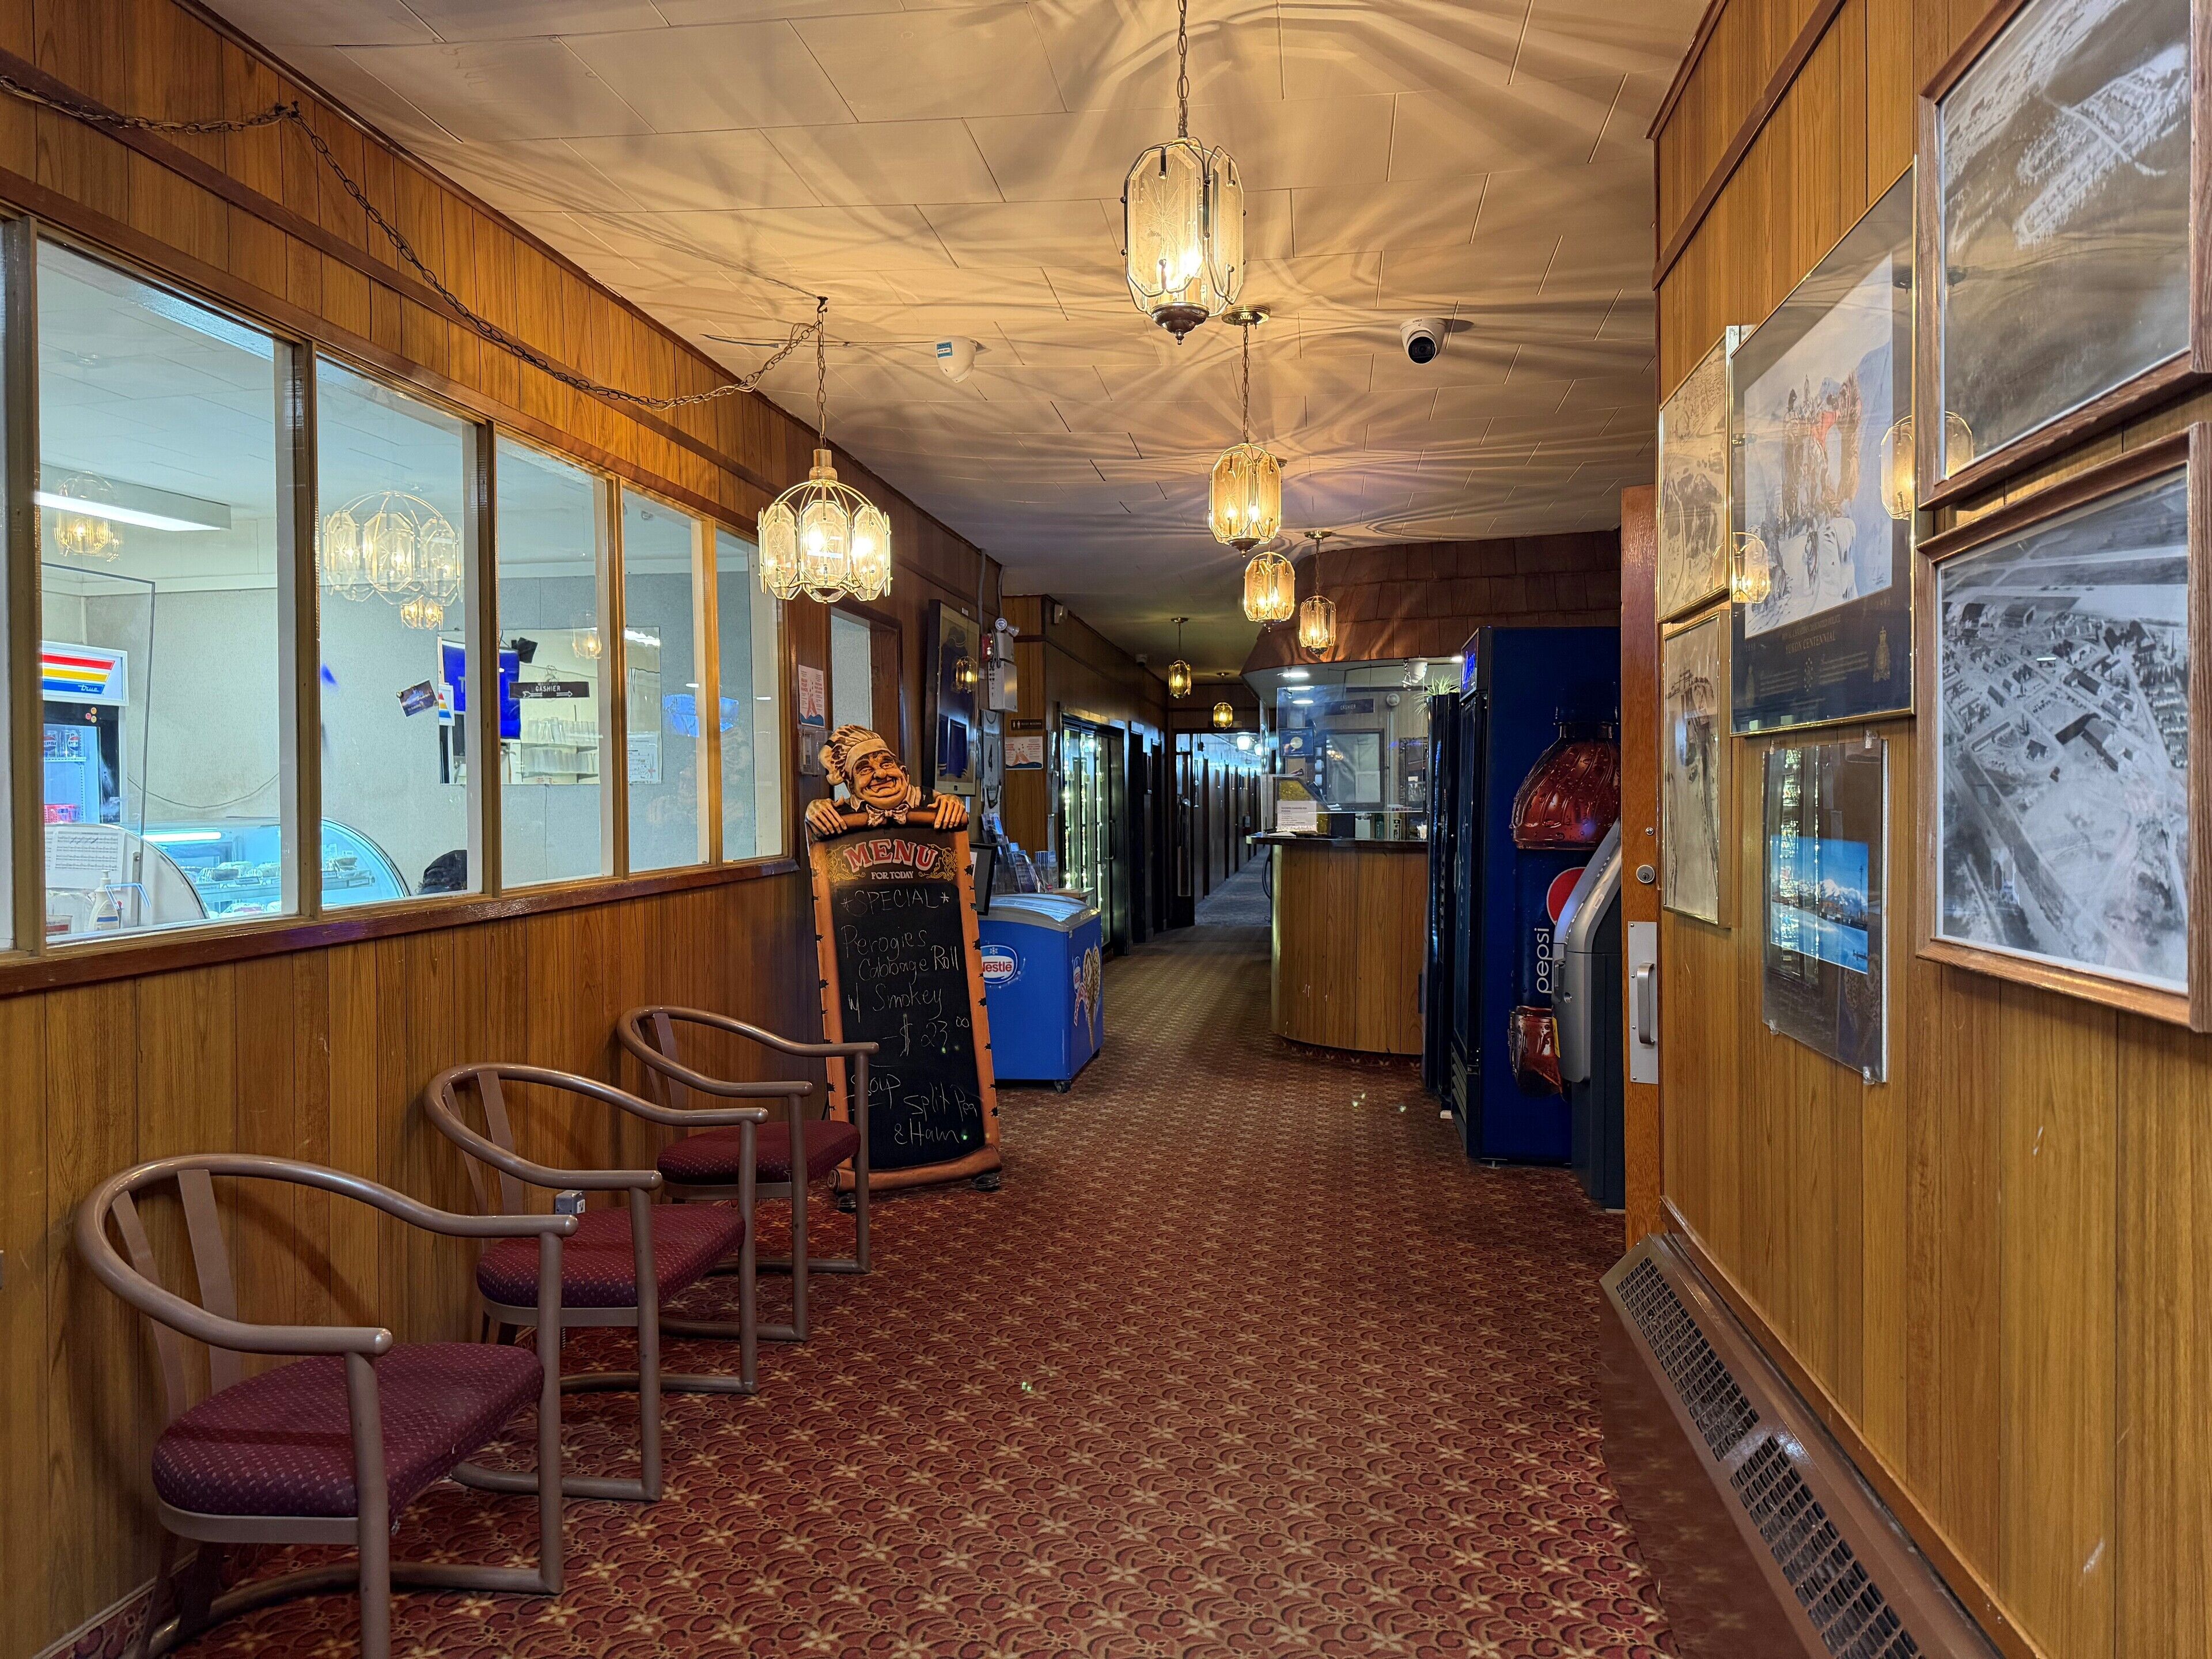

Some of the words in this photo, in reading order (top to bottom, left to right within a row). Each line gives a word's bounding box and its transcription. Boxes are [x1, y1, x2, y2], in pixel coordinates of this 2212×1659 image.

[843, 838, 938, 873] MENU
[871, 872, 889, 880] FOR
[889, 871, 914, 879] TODAY
[840, 925, 927, 961] Perogies
[1534, 927, 1554, 994] pepsi
[859, 956, 930, 985] Cabbage
[931, 945, 959, 971] Roll
[872, 982, 942, 1021] Smokey
[903, 1082, 950, 1122] Split
